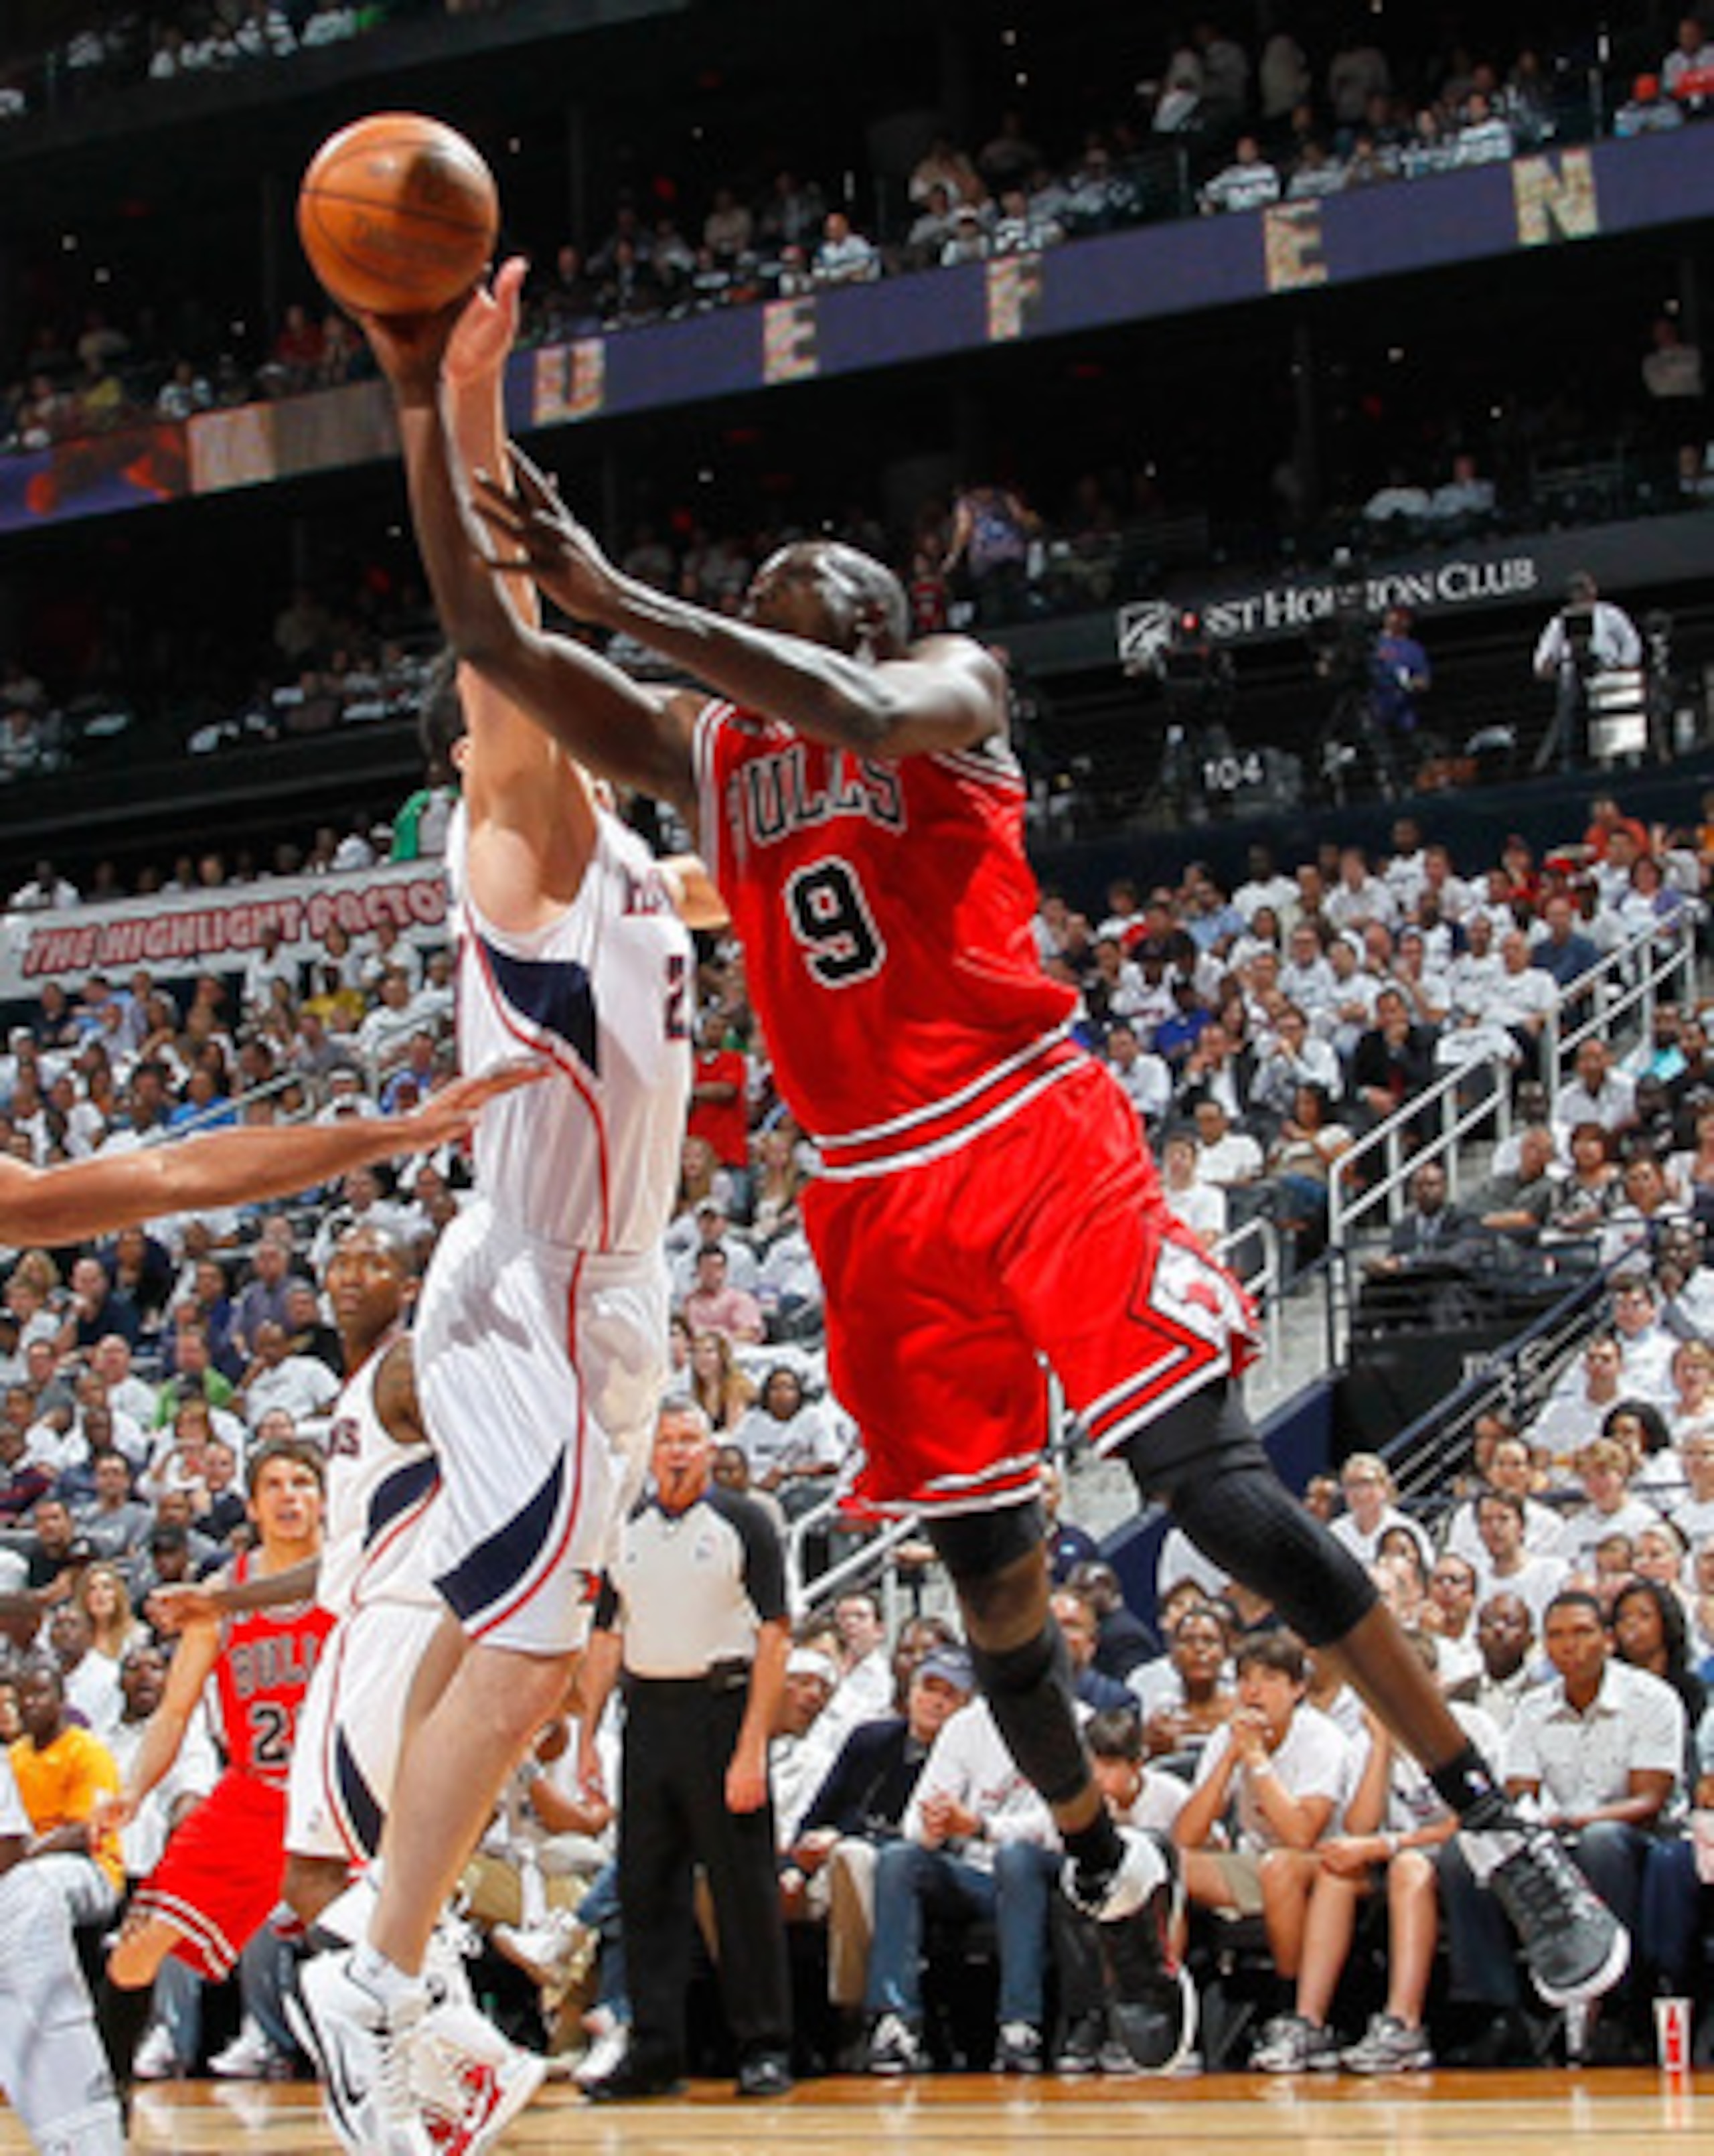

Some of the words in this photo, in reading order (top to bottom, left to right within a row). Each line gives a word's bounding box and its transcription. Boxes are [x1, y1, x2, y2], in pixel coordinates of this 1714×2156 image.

[1437, 558, 1538, 601] CLUB
[1204, 751, 1264, 790] 104
[23, 923, 104, 977] THE
[95, 897, 303, 968] HIGHLIGHT
[307, 877, 447, 941] FACTO
[784, 854, 888, 990] 9
[248, 1701, 301, 1766] 2
